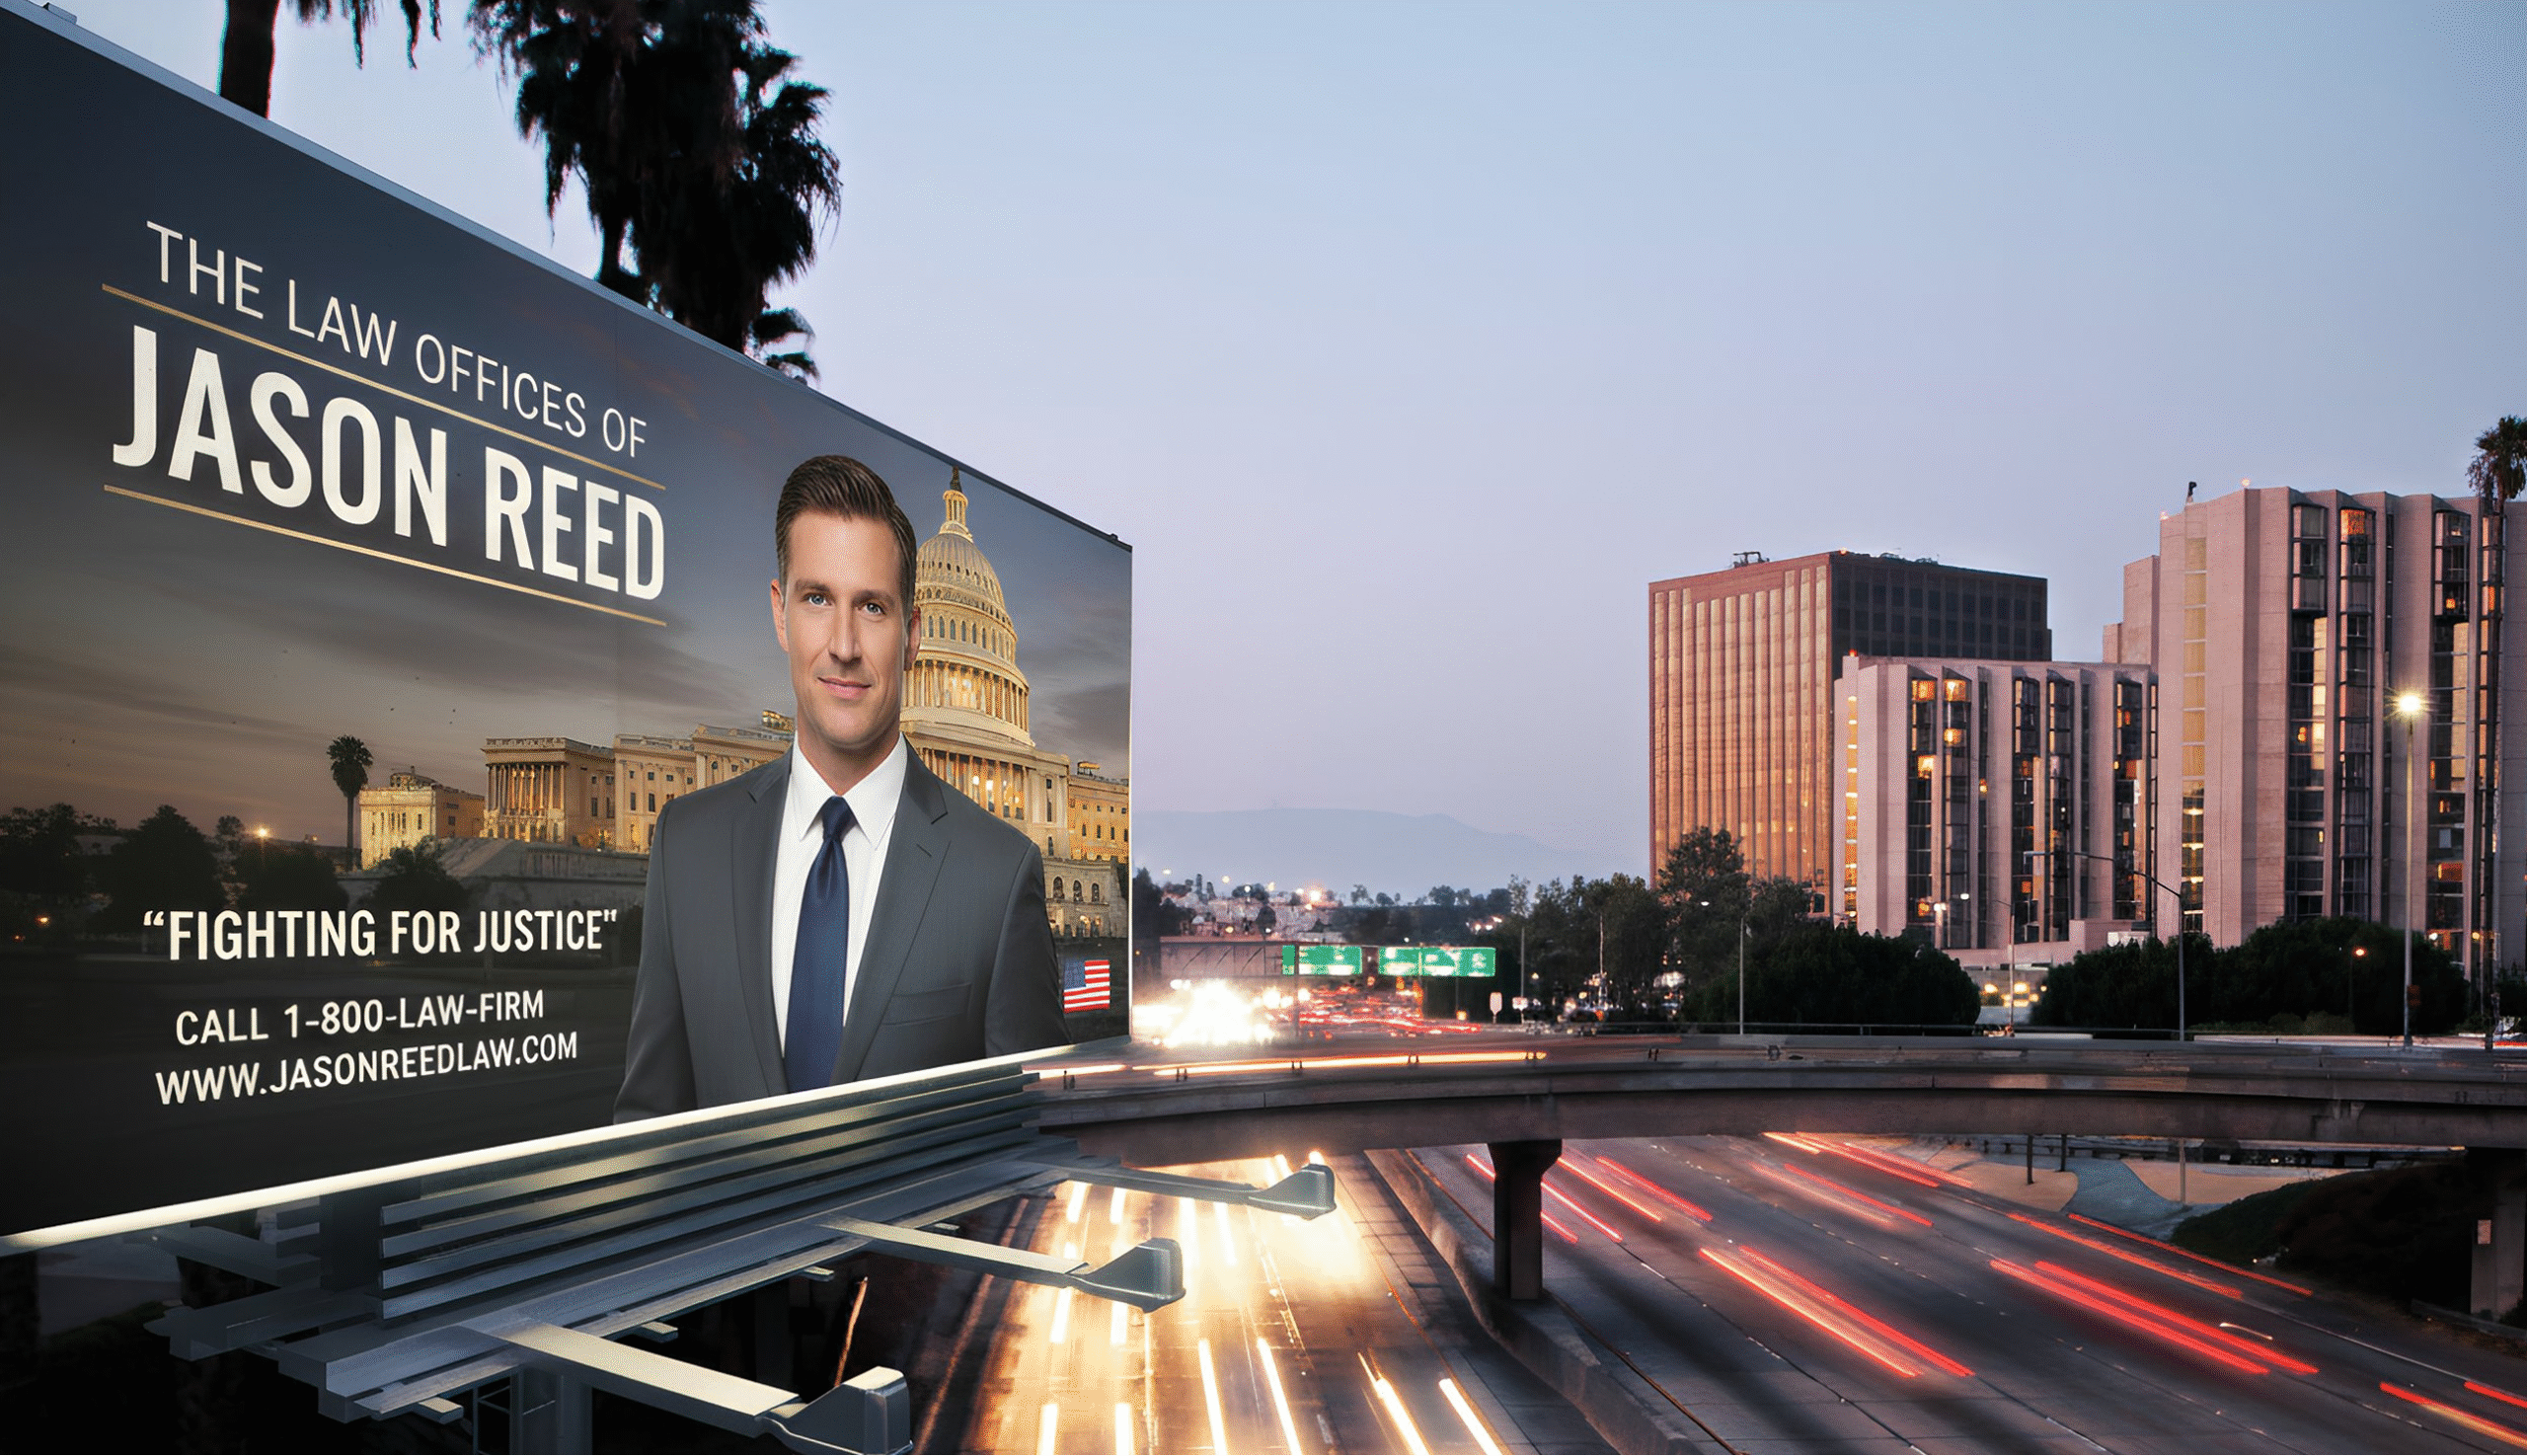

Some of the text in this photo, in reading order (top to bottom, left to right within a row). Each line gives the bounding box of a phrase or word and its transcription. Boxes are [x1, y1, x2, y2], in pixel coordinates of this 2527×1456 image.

[146, 219, 648, 458] THE LAW OFFICES OF
[113, 324, 665, 601] JASON REED
[391, 909, 461, 955] FOR
[176, 989, 544, 1045] CALL 1-800-LAW-FIRM
[155, 1031, 577, 1106] WWW.JASONREEDLAW.COM
